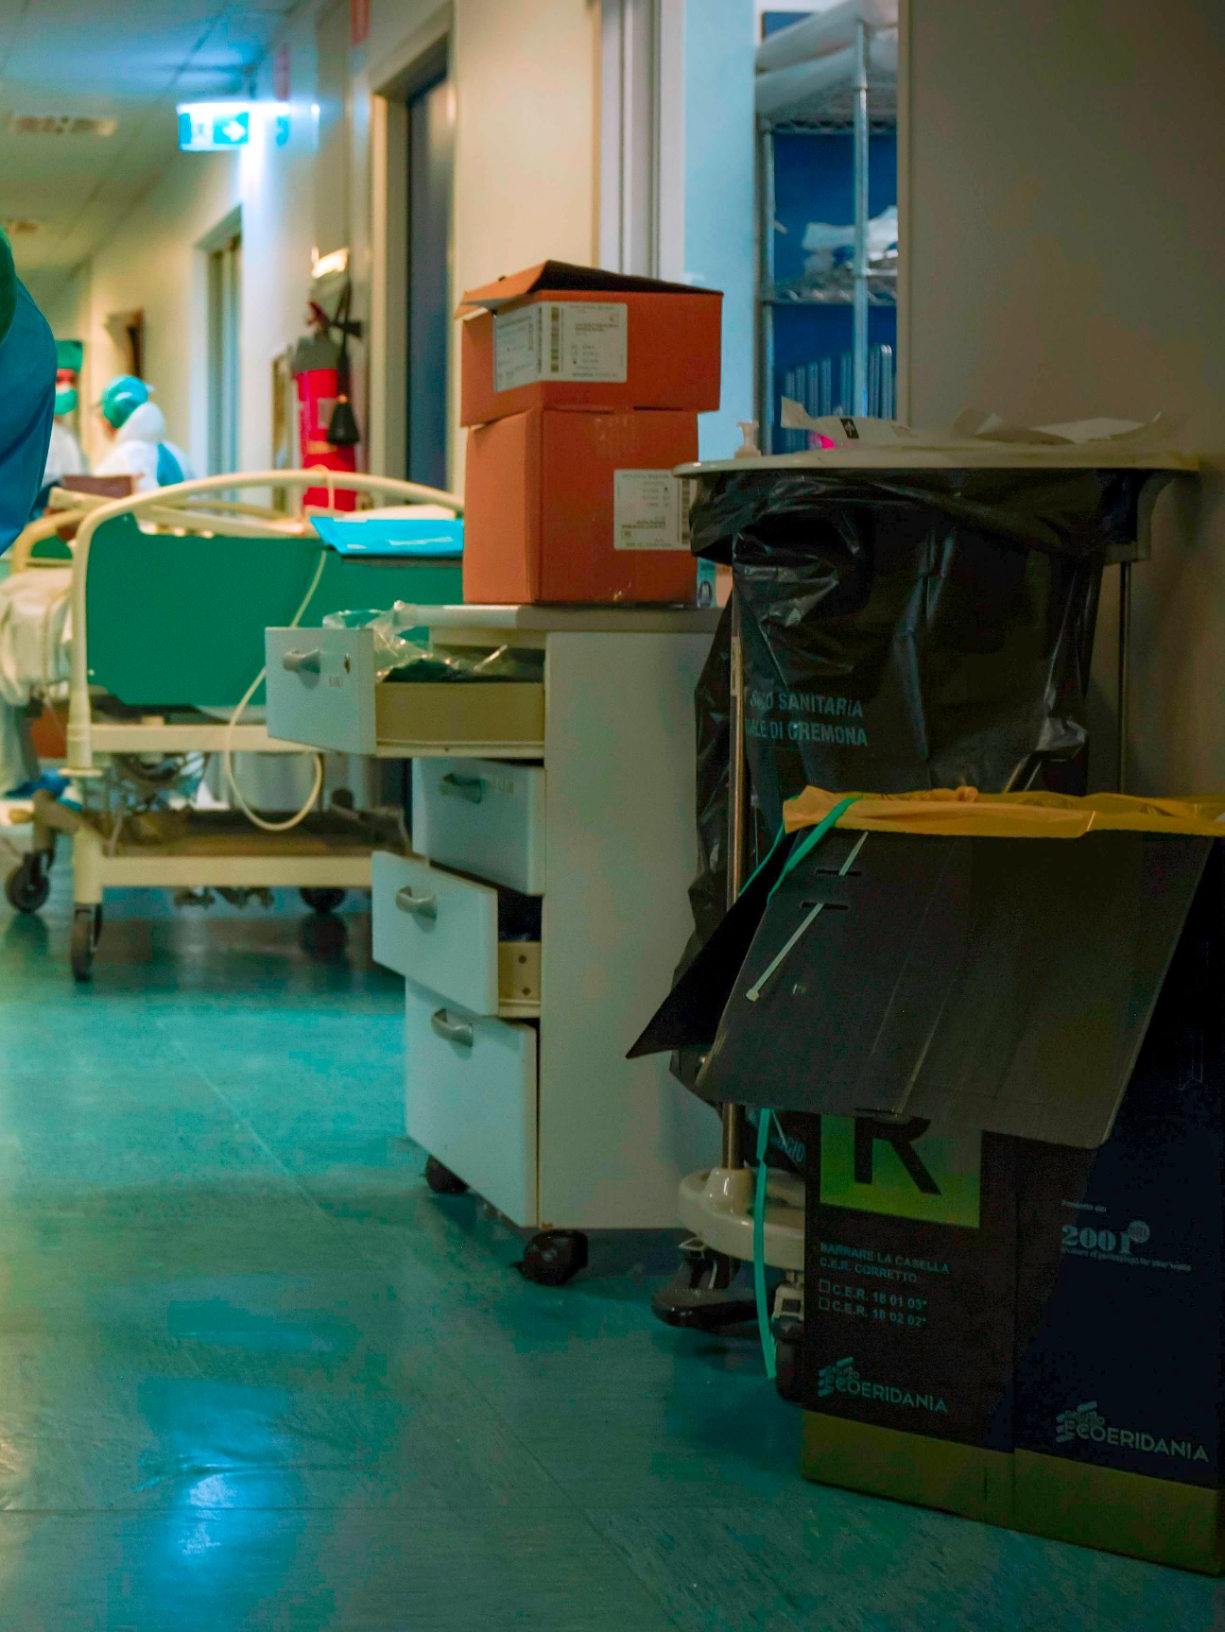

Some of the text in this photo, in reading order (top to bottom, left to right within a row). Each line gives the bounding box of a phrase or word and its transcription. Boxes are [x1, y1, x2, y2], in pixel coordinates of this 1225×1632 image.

[778, 692, 864, 718] SANITARIA
[770, 720, 784, 740] DI
[787, 720, 868, 747] CREMONA
[855, 1264, 917, 1283] CORRETTO
[889, 1294, 903, 1307] 01
[889, 1311, 904, 1325] 02
